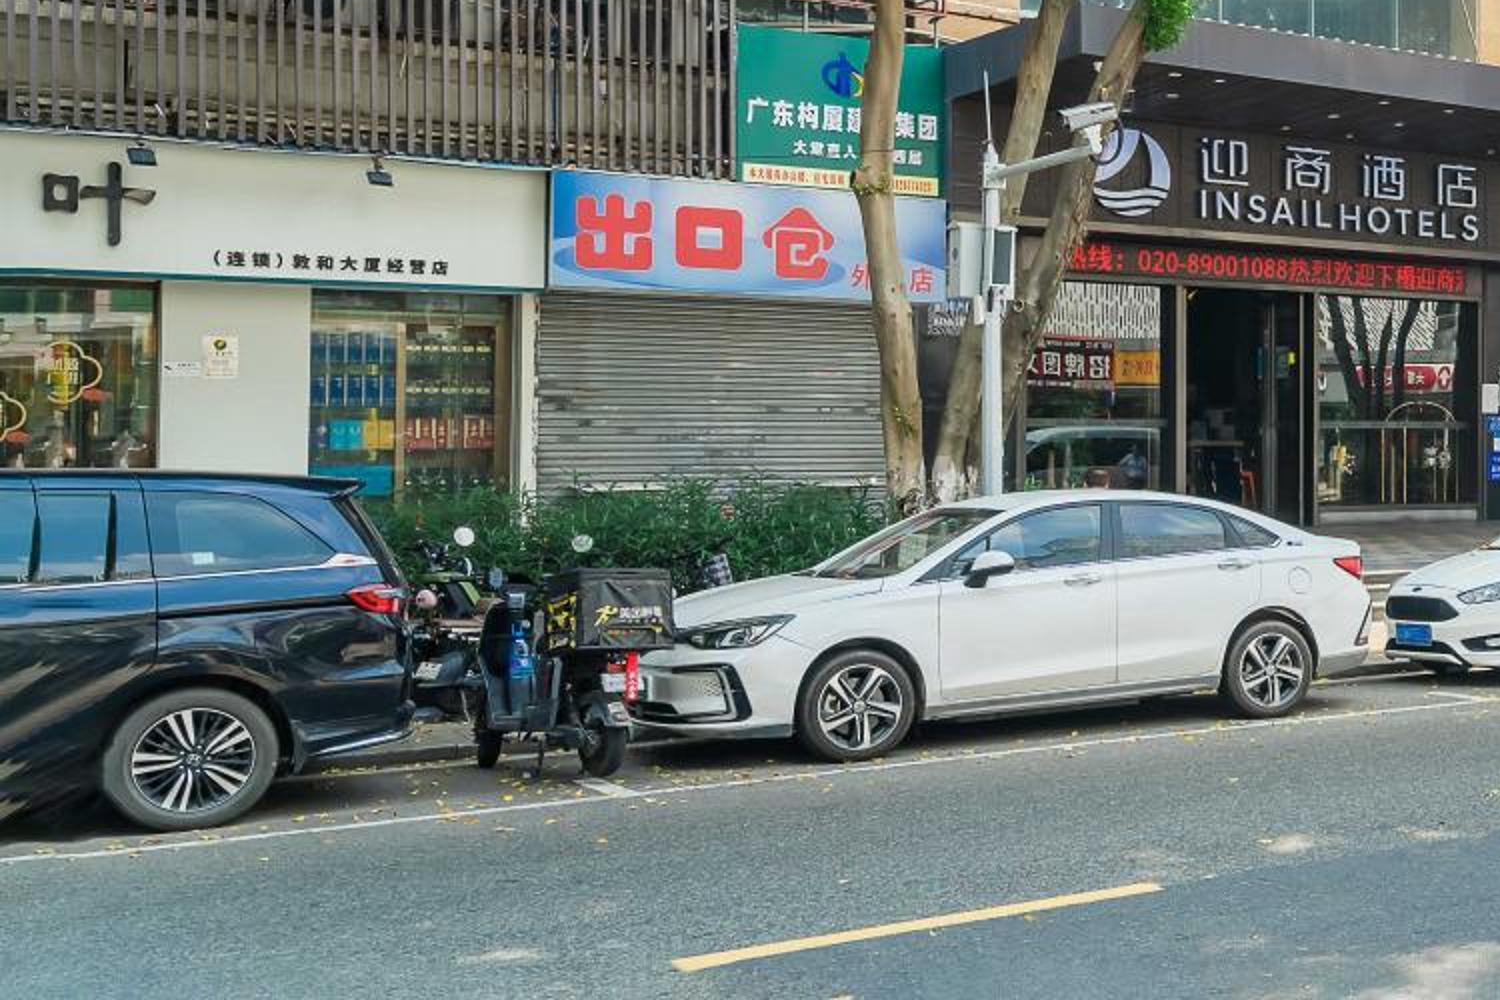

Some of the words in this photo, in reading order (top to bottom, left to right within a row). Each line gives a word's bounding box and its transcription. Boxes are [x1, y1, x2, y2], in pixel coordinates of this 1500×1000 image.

[1201, 137, 1477, 208] 迎商酒店
[574, 193, 835, 281] 出口仓
[850, 264, 934, 293] 外店
